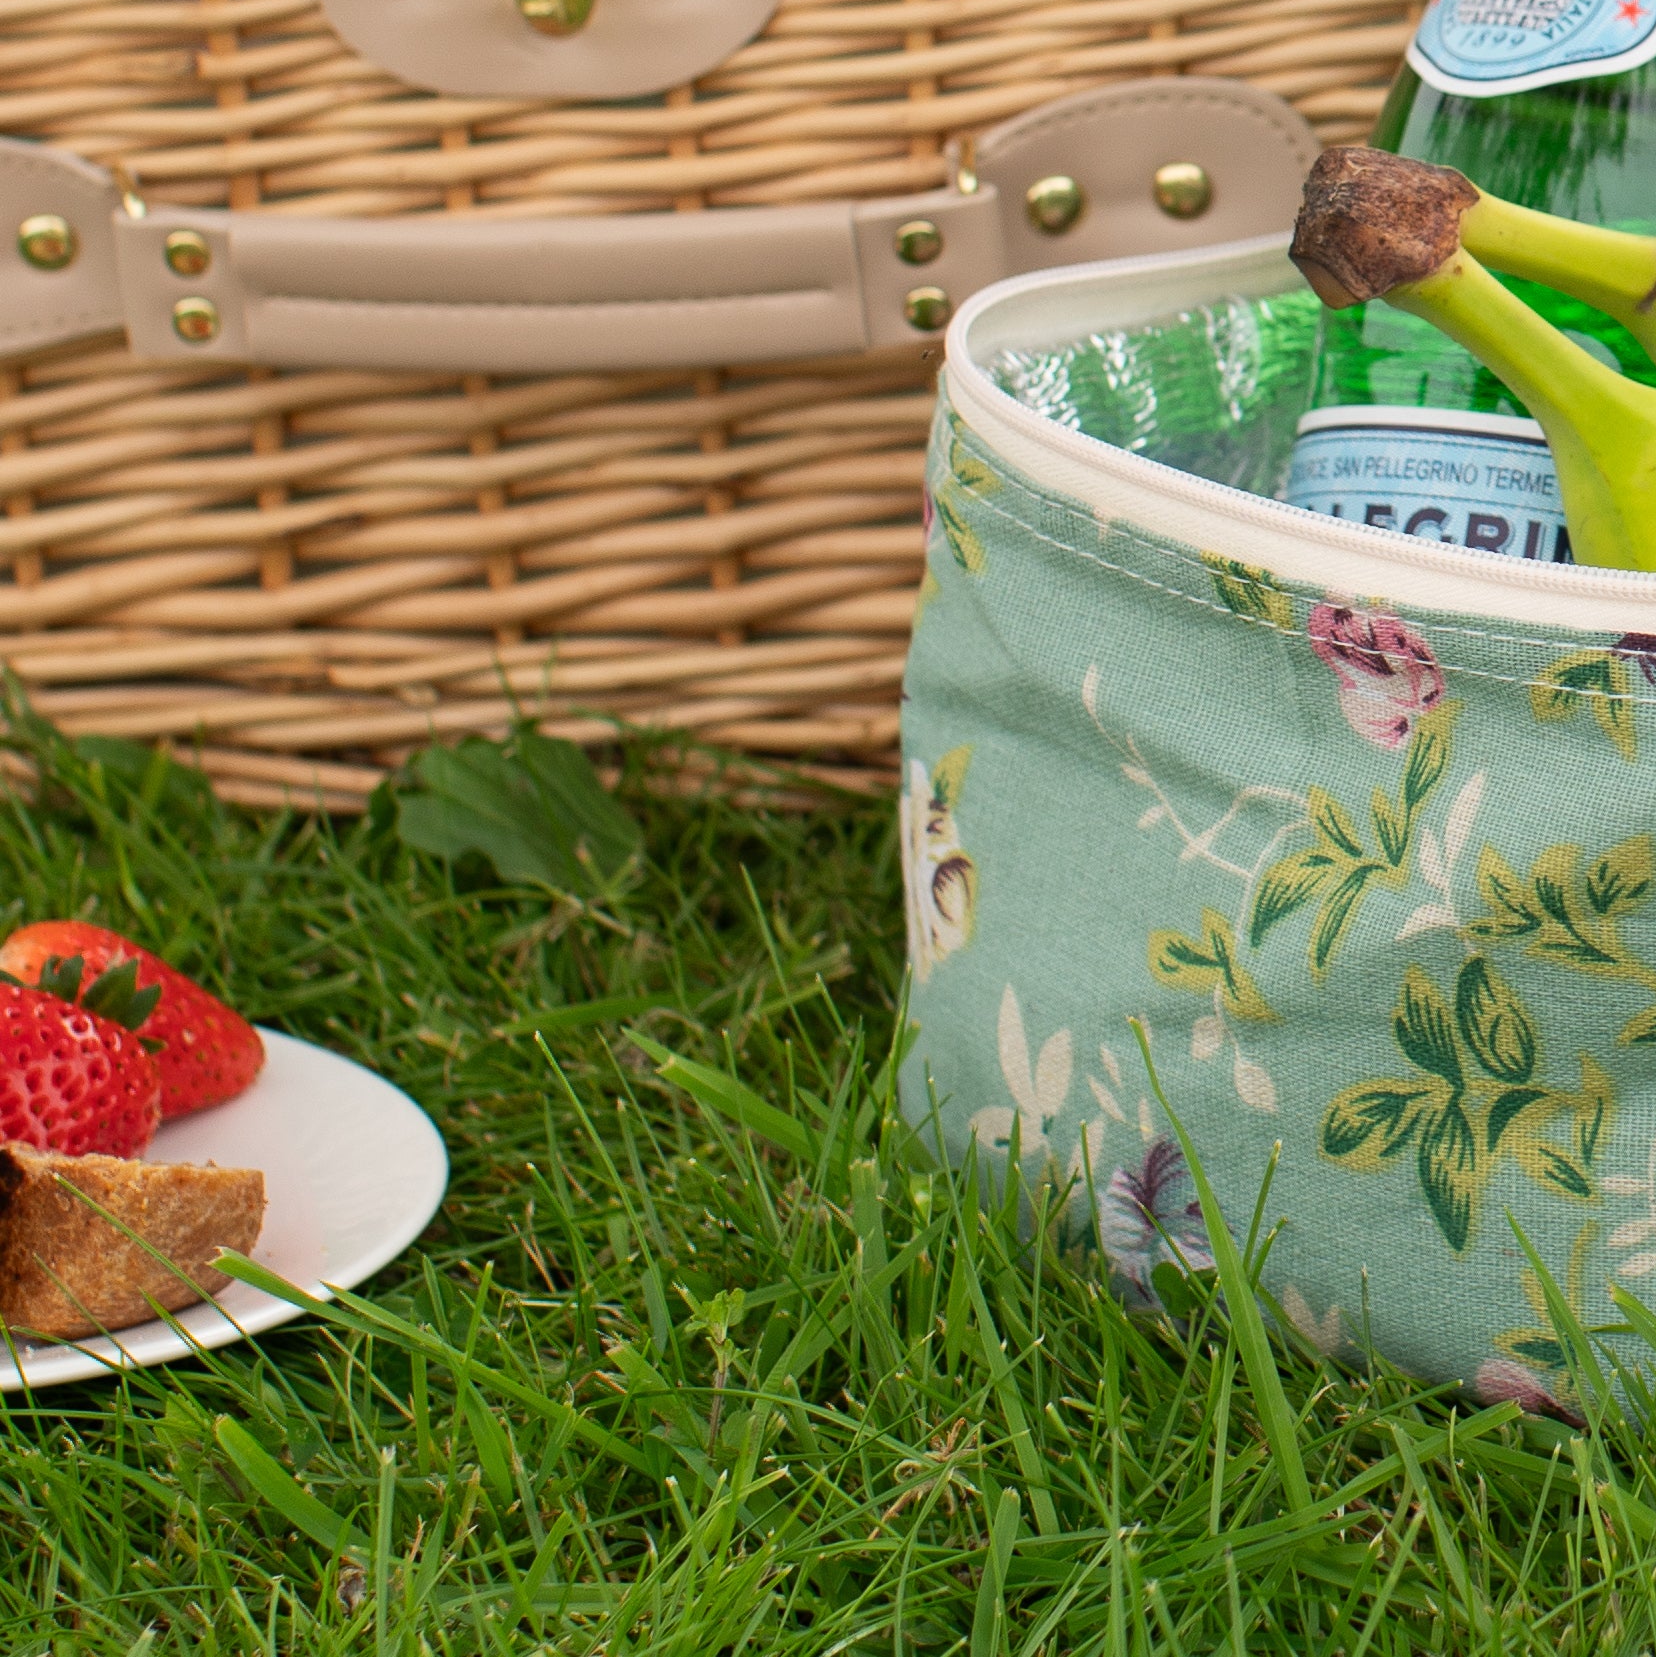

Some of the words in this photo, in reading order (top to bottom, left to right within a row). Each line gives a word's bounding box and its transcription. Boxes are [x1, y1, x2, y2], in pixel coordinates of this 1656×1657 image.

[1457, 26, 1527, 50] 1899
[1332, 455, 1363, 479] SAN
[1364, 456, 1479, 487] PELLEGRINO
[1486, 465, 1556, 496] TERME
